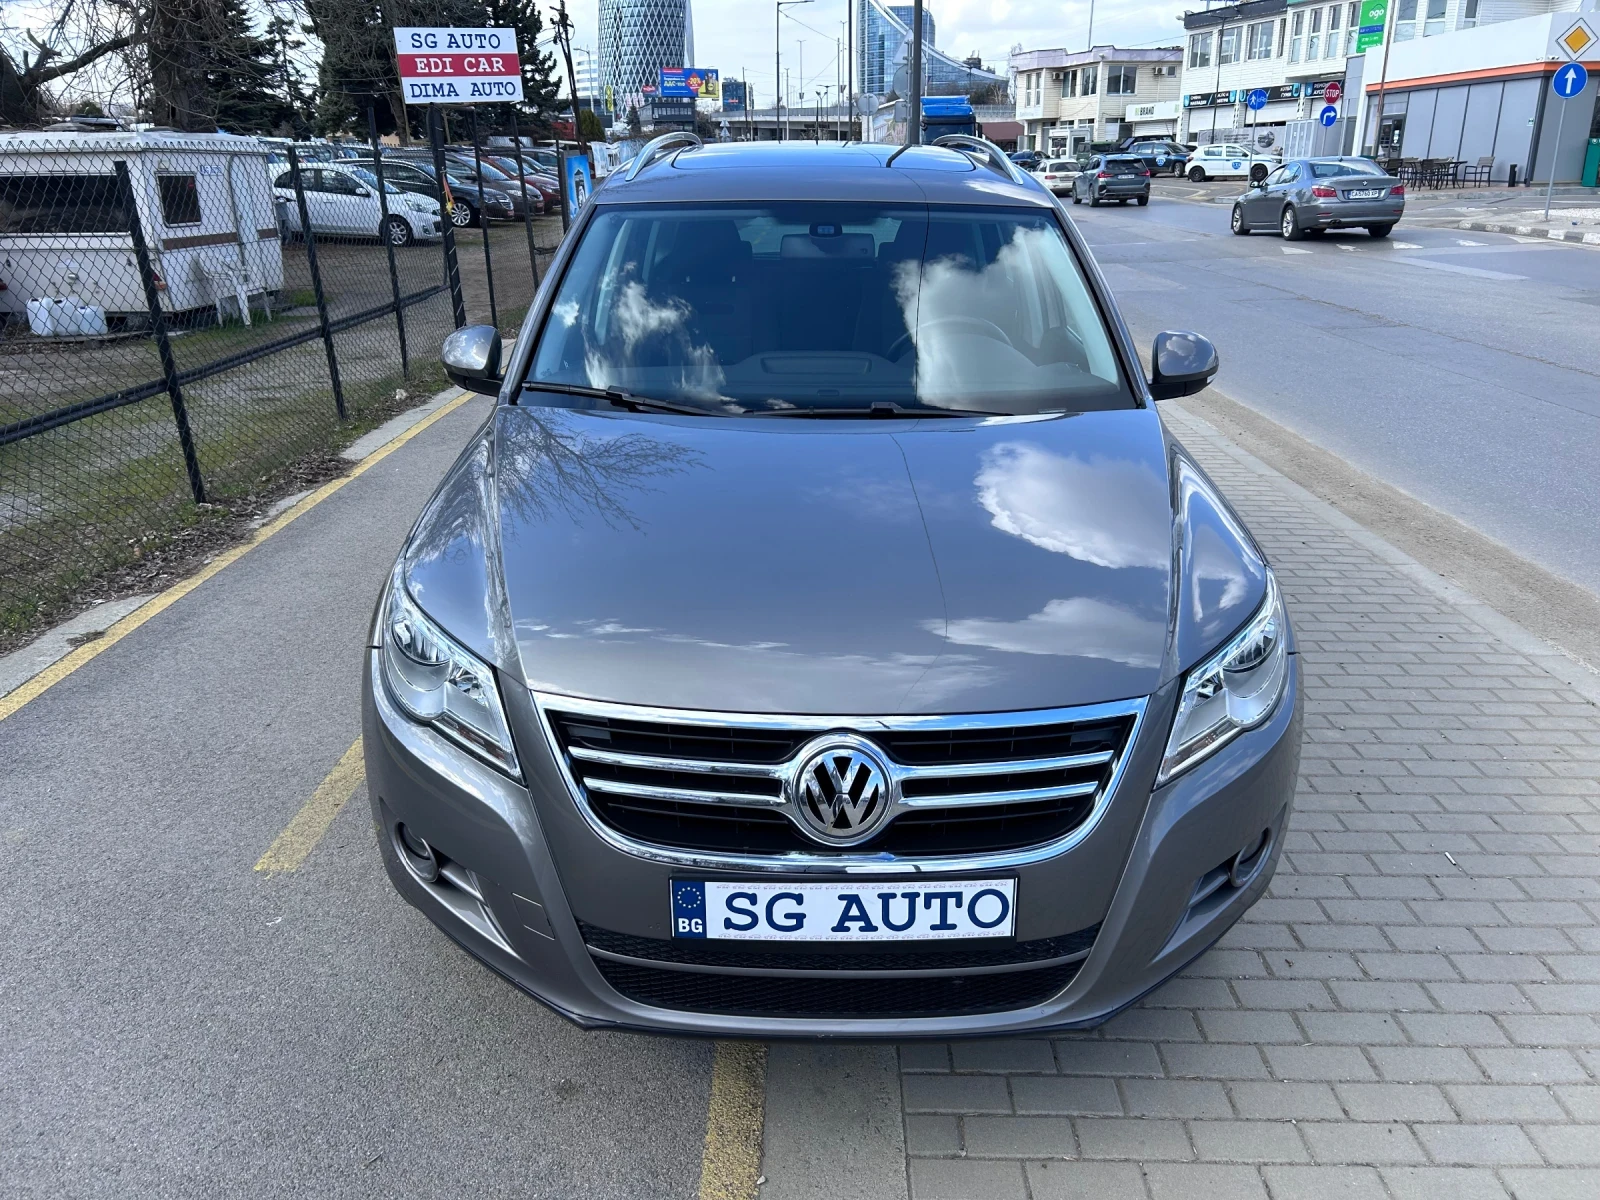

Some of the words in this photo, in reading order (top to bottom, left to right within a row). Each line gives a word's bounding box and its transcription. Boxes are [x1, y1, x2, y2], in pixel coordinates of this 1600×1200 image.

[411, 32, 438, 49] SG
[447, 33, 501, 49] AUTO
[414, 57, 454, 73] EDI
[463, 57, 506, 73] CAR
[409, 82, 460, 98] DIMA
[470, 81, 516, 97] AUTO
[1325, 88, 1340, 98] STOP
[723, 892, 808, 932] SG
[830, 888, 1010, 933] AUTO
[677, 918, 703, 934] BG
